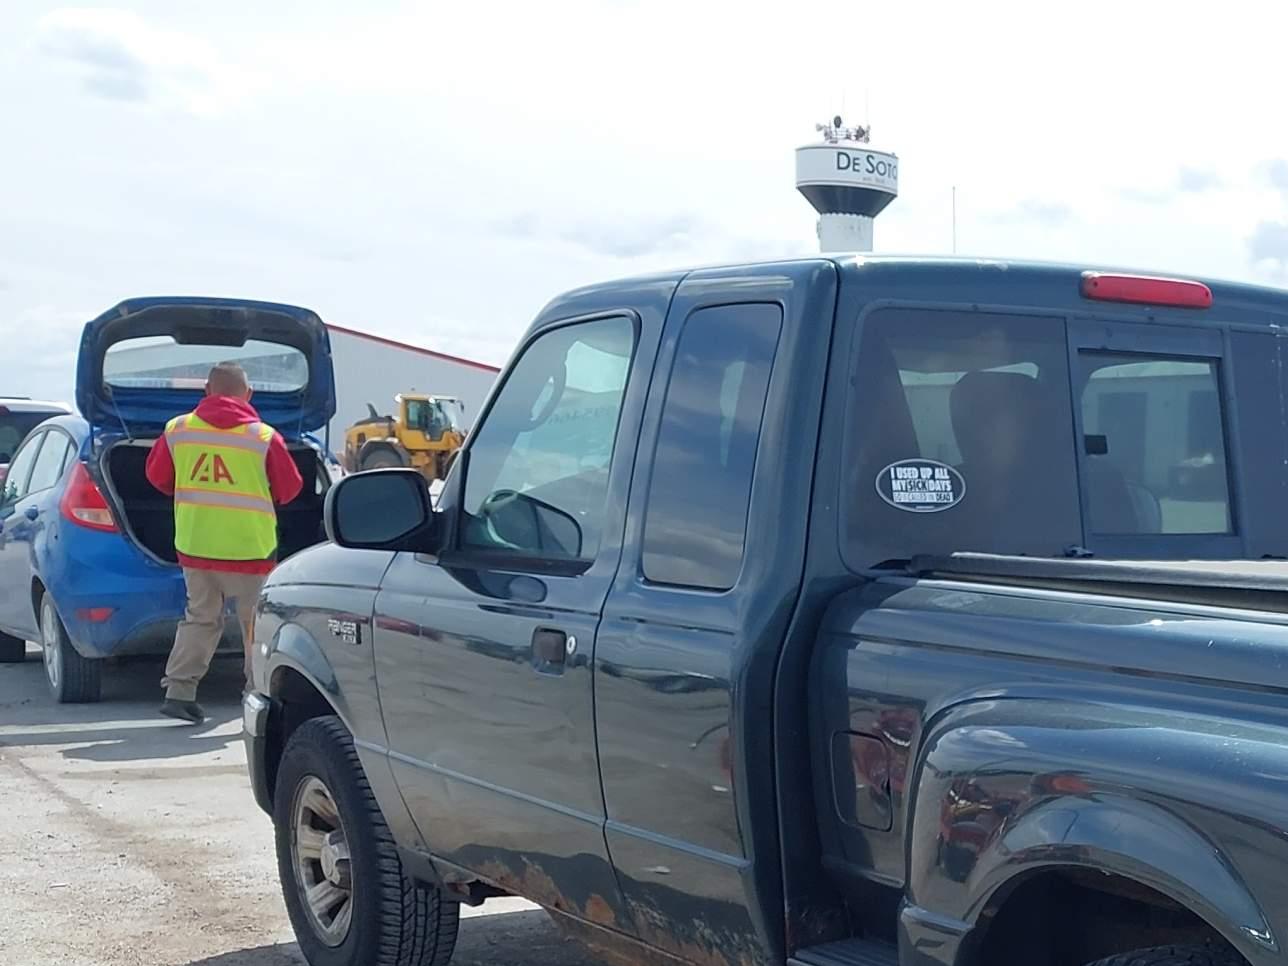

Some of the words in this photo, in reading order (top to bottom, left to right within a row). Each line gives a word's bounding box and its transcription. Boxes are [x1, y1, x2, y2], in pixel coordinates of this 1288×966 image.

[890, 467, 896, 479] I
[896, 467, 919, 479] USED
[920, 467, 933, 479] UP
[934, 467, 950, 479] ALL
[892, 479, 907, 491] MY
[906, 479, 929, 491] SICK
[929, 479, 952, 491] DAYS
